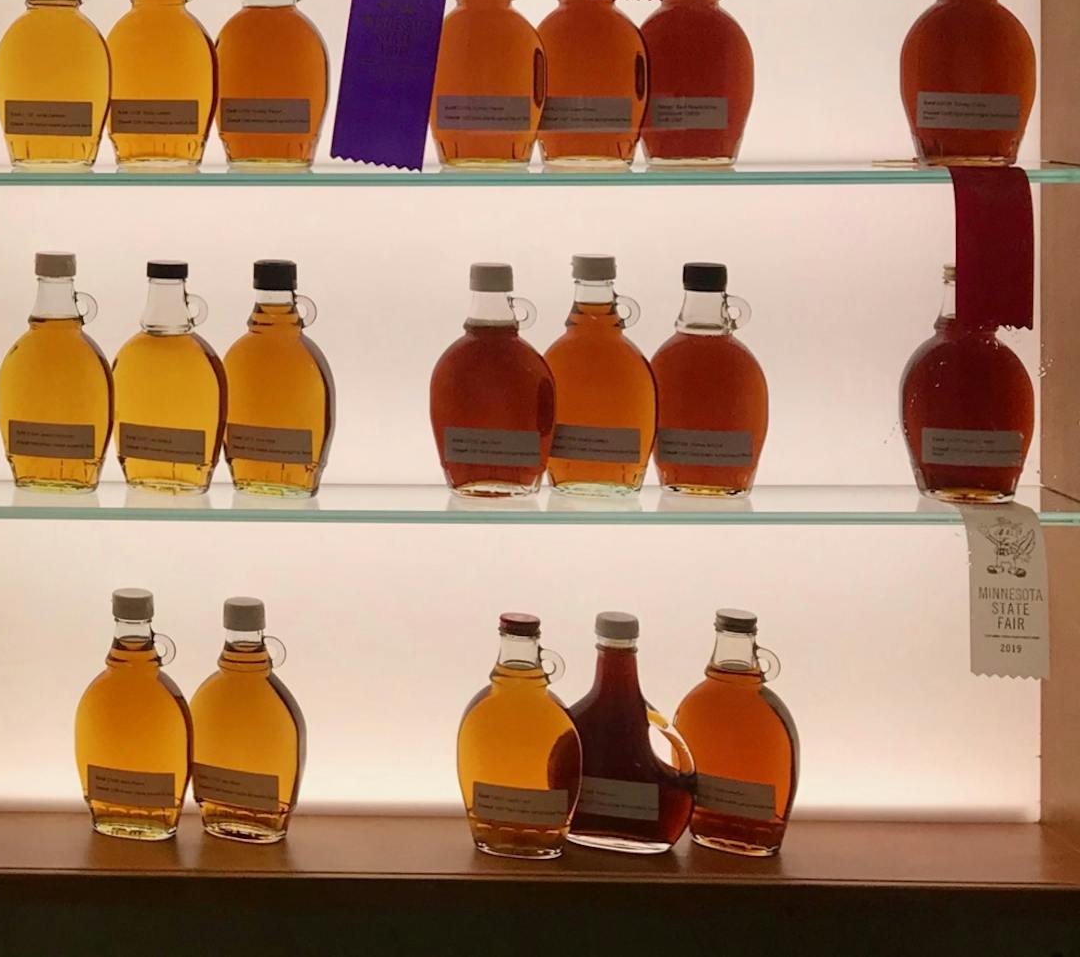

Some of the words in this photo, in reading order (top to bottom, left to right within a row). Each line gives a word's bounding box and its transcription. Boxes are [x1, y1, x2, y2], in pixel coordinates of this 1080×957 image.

[978, 586, 1044, 602] MINNESOTA
[991, 602, 1030, 616] STATE
[997, 616, 1025, 630] FAIR
[999, 643, 1022, 653] 2019
